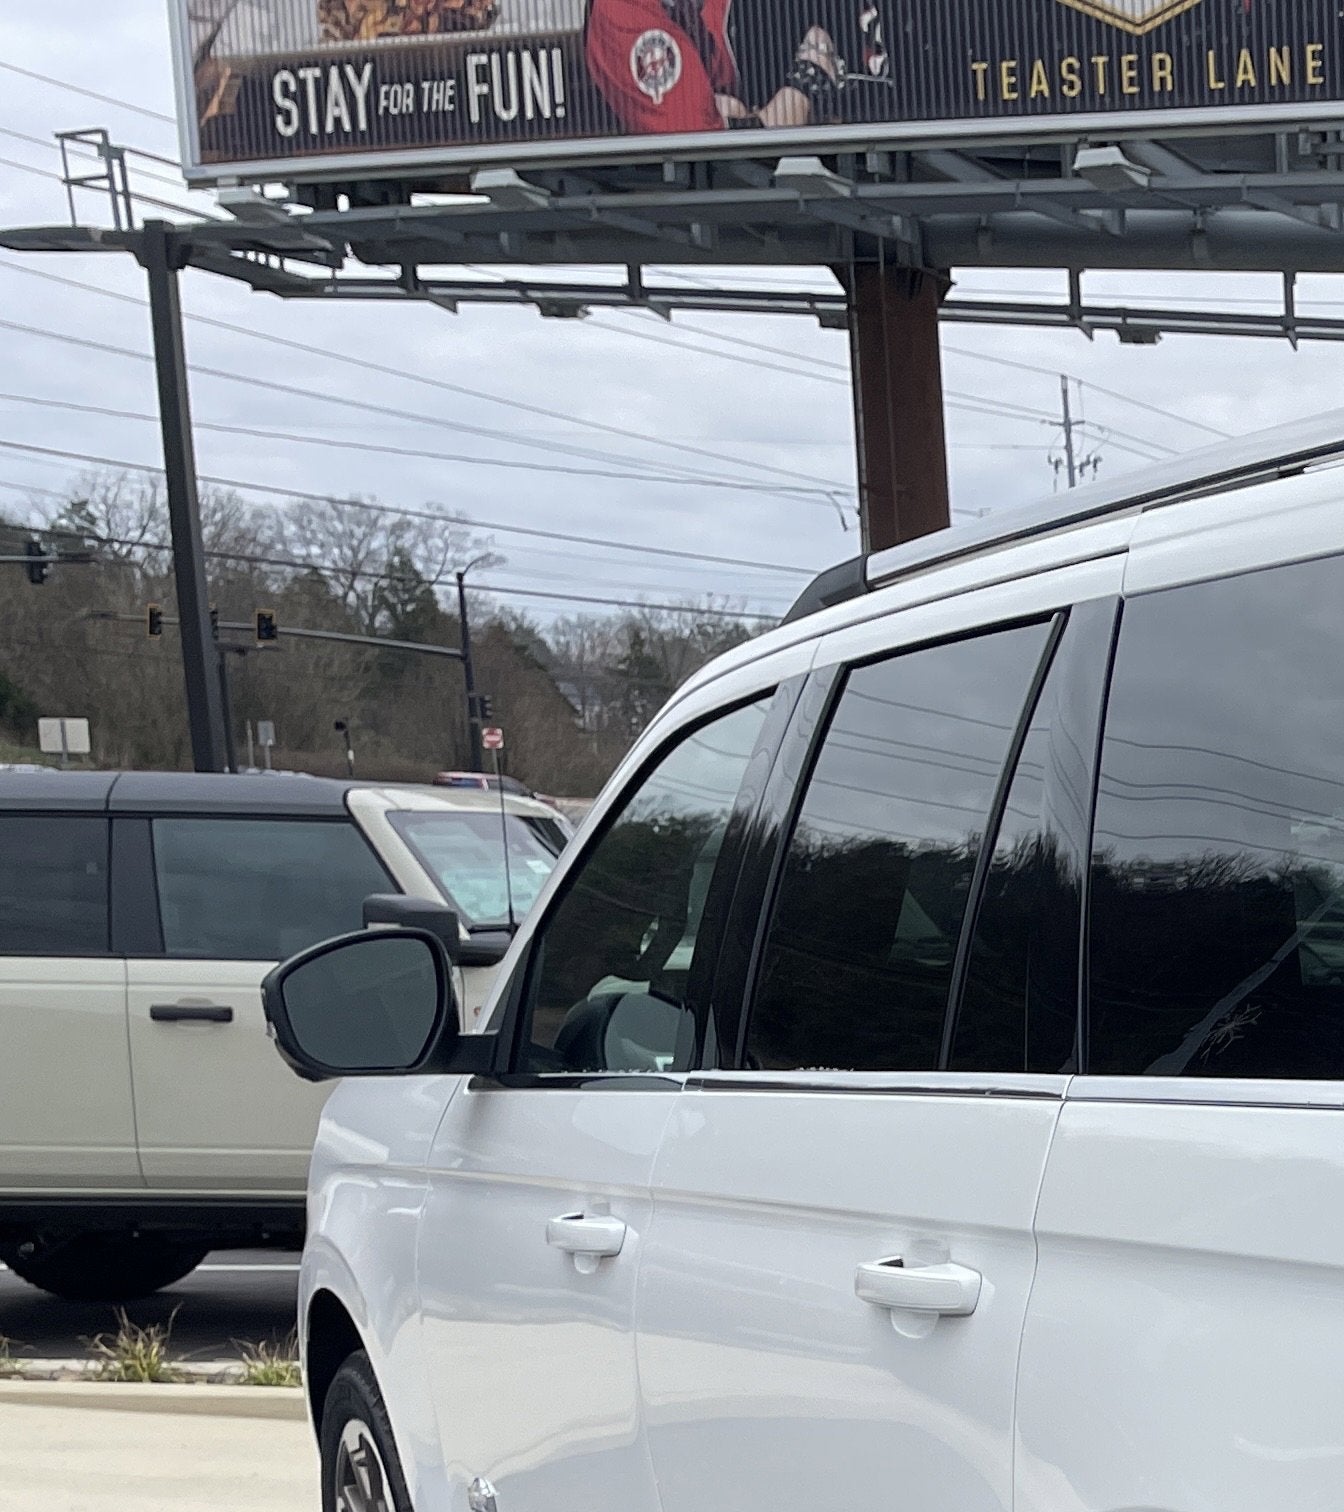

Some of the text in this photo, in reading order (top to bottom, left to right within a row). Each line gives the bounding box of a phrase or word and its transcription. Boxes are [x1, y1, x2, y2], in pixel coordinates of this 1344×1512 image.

[273, 47, 566, 138] STAY FOR THE FUN!
[971, 43, 1324, 101] TEASTER LANE
